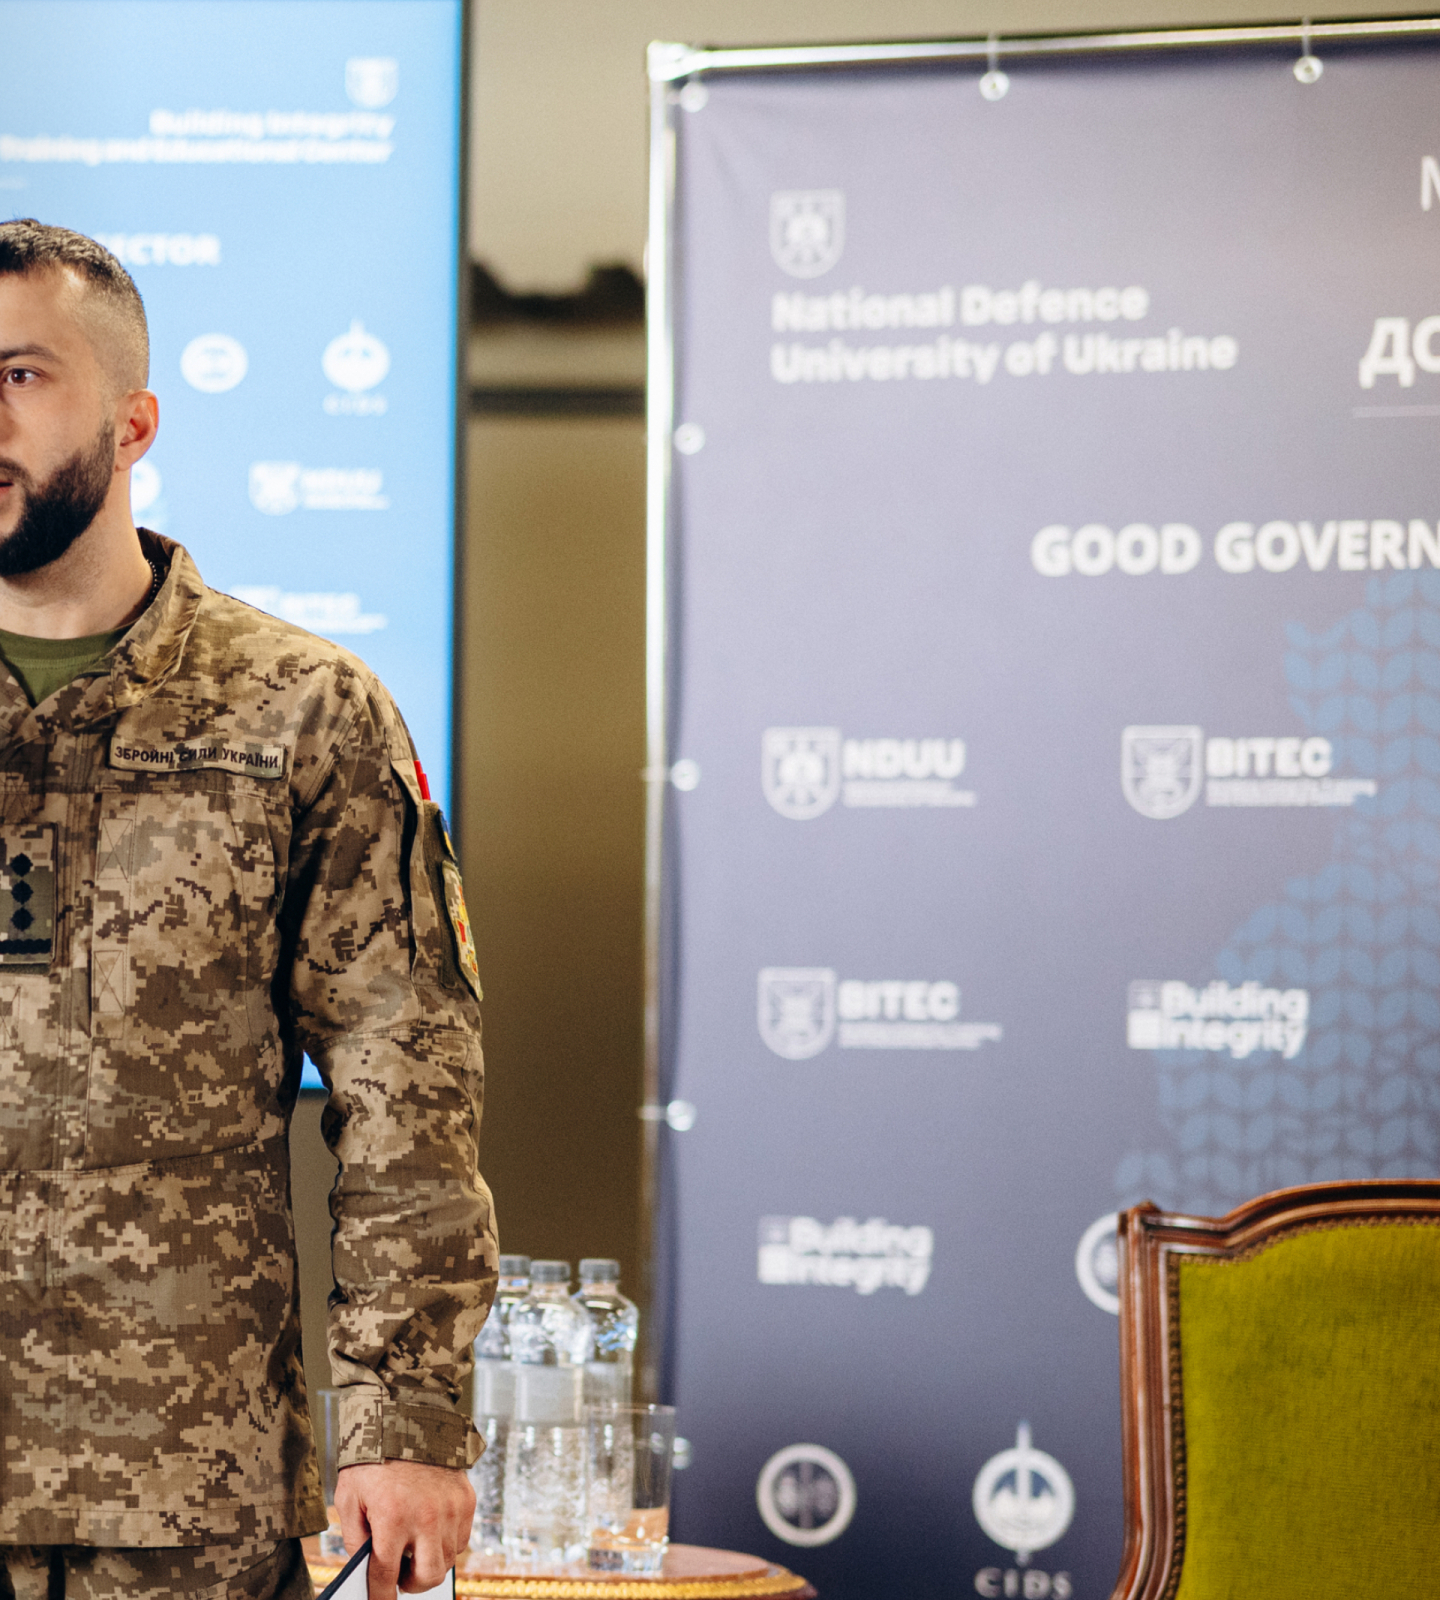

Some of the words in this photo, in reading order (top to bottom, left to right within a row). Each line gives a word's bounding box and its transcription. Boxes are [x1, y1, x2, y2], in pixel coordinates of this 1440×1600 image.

[94, 233, 221, 267] ECTOR
[771, 286, 954, 332] National
[962, 281, 1150, 325] Defence
[770, 336, 998, 385] University
[1005, 330, 1057, 377] of
[1063, 328, 1239, 375] Ukraine
[1030, 522, 1202, 577] GOOD
[114, 745, 174, 764] ЗБРОЙНІ
[178, 747, 218, 762] СИЛИ
[222, 747, 279, 768] УКРАЇНИ
[843, 738, 966, 779] NDUU
[1206, 737, 1333, 779] BITEC
[838, 980, 960, 1022] BITEC
